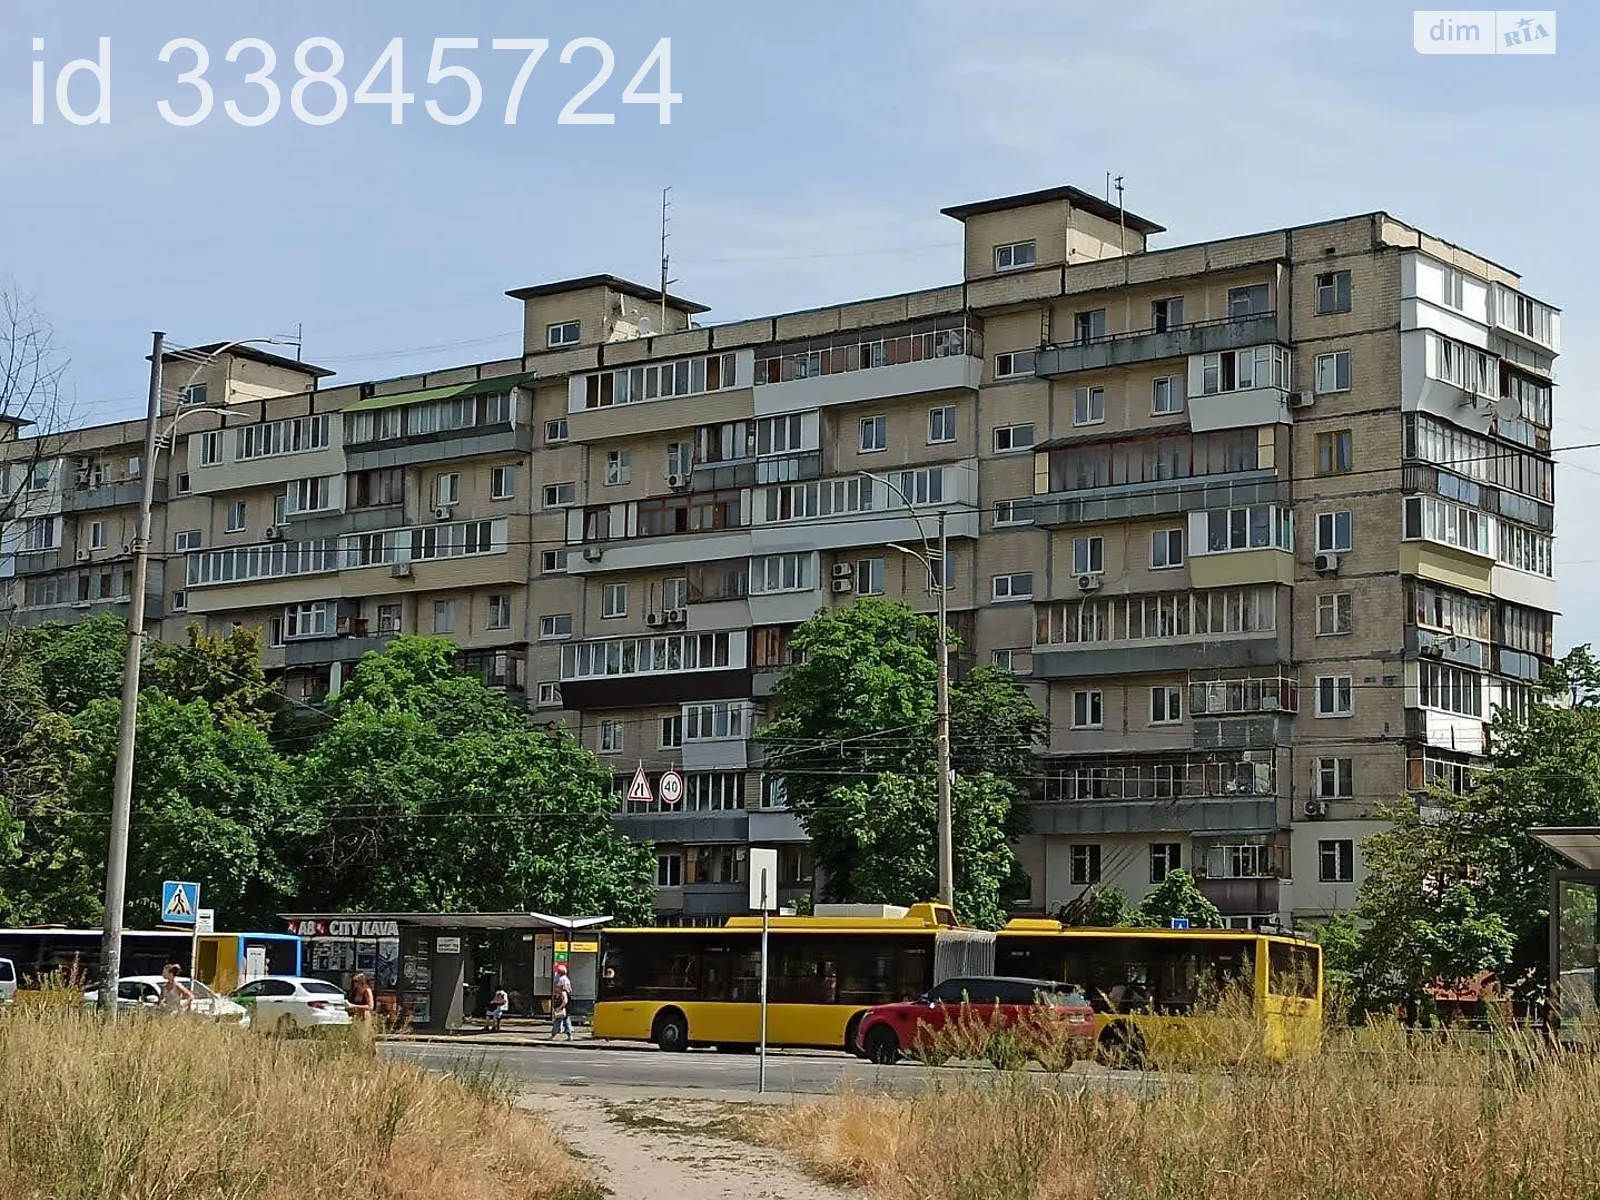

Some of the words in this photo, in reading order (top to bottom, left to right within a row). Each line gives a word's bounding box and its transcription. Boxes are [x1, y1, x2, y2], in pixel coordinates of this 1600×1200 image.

[664, 780, 678, 793] 40
[329, 920, 361, 936] CITY
[361, 920, 400, 936] KAVA
